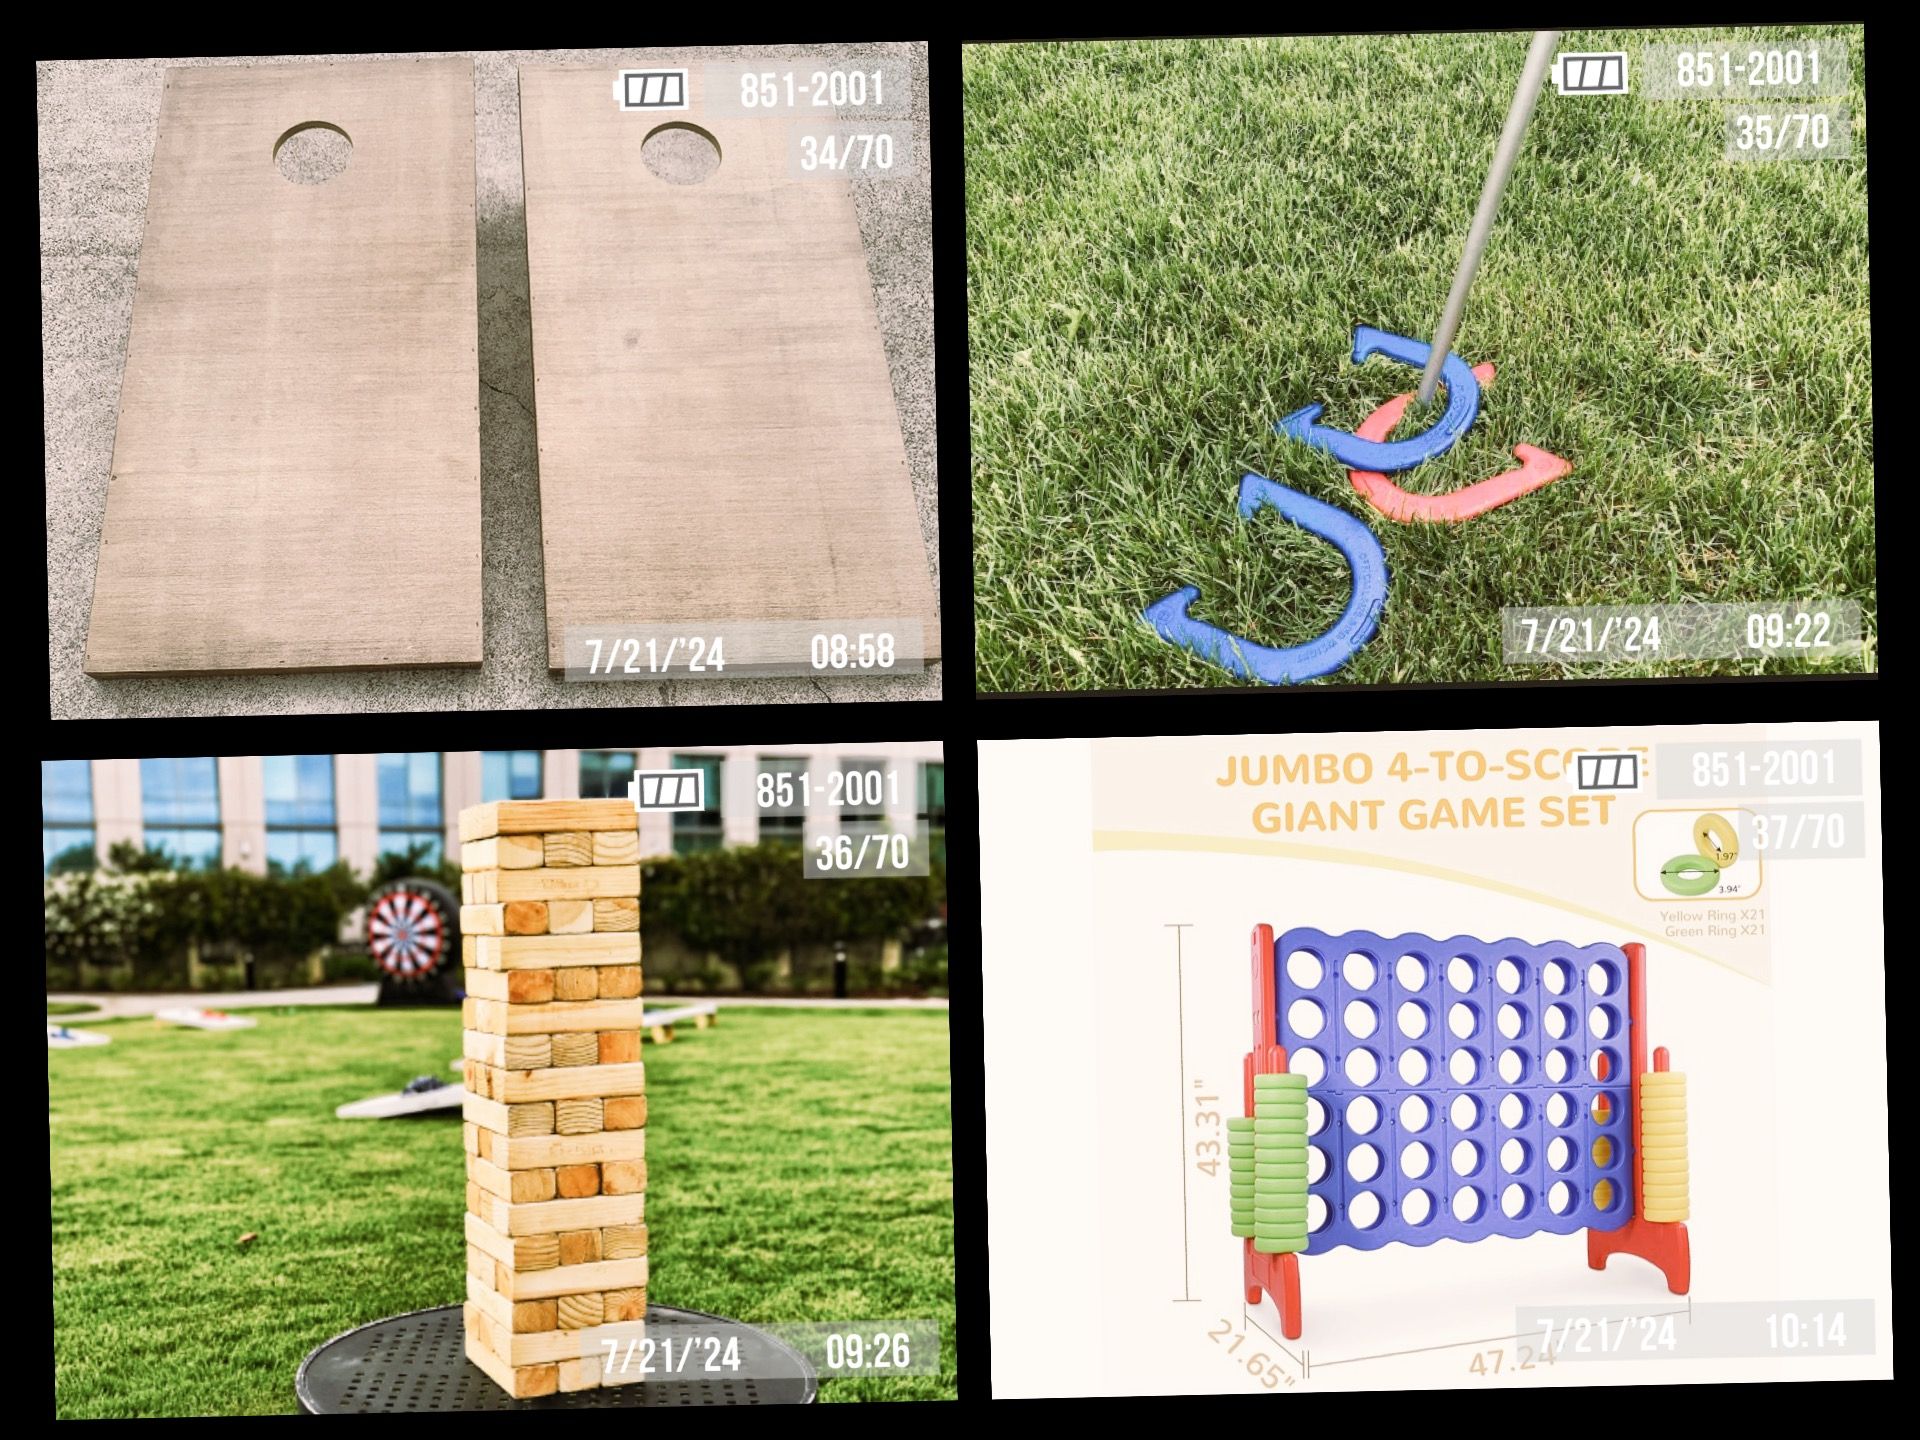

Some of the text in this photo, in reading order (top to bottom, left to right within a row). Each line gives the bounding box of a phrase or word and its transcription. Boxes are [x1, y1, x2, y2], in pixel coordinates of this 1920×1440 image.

[1216, 747, 1649, 788] JUMBO 4-TO-SC
[1251, 795, 1616, 834] GIANT GAME SET
[1660, 909, 1765, 923] Yellow Ring X21
[1665, 924, 1765, 939] Green Ring X21
[1194, 1079, 1221, 1177] 43.31"
[1207, 1318, 1296, 1389] 21.65"
